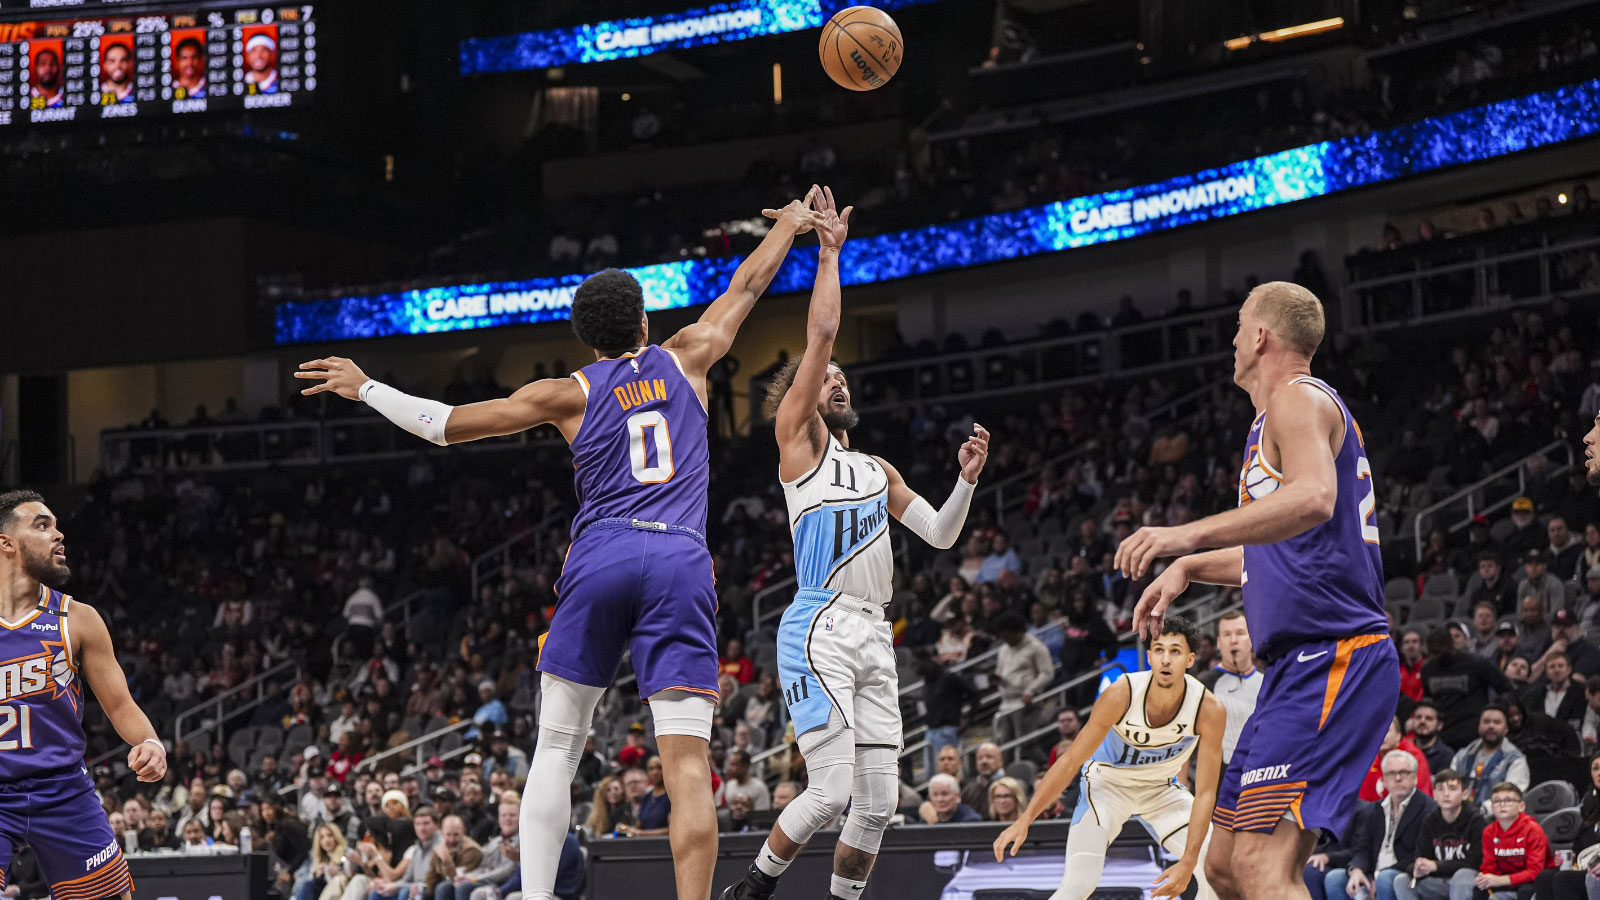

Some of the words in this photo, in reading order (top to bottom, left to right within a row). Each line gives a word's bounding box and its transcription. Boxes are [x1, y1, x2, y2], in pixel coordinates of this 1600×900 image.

[208, 12, 224, 27] %
[261, 8, 274, 24] 0
[301, 5, 313, 21] 7
[73, 20, 105, 37] 25%
[136, 16, 169, 33] 25%
[596, 27, 651, 51] CARE
[651, 8, 761, 44] INNOVATION
[172, 98, 208, 113] DUNN
[244, 92, 292, 109] BOOKER
[31, 106, 77, 122] DURANT
[101, 103, 137, 118] JONES
[1070, 201, 1132, 234] CARE
[1133, 174, 1256, 222] INNOVATION
[427, 294, 488, 320] CARE
[489, 285, 578, 315] INNOVA
[613, 379, 667, 411] DUNN
[627, 411, 675, 484] 0
[830, 458, 859, 493] 11
[31, 622, 58, 632] PayPal
[785, 675, 810, 707] atl
[0, 704, 34, 750] 21
[1125, 729, 1150, 745] 10
[1240, 763, 1292, 788] HOENIX
